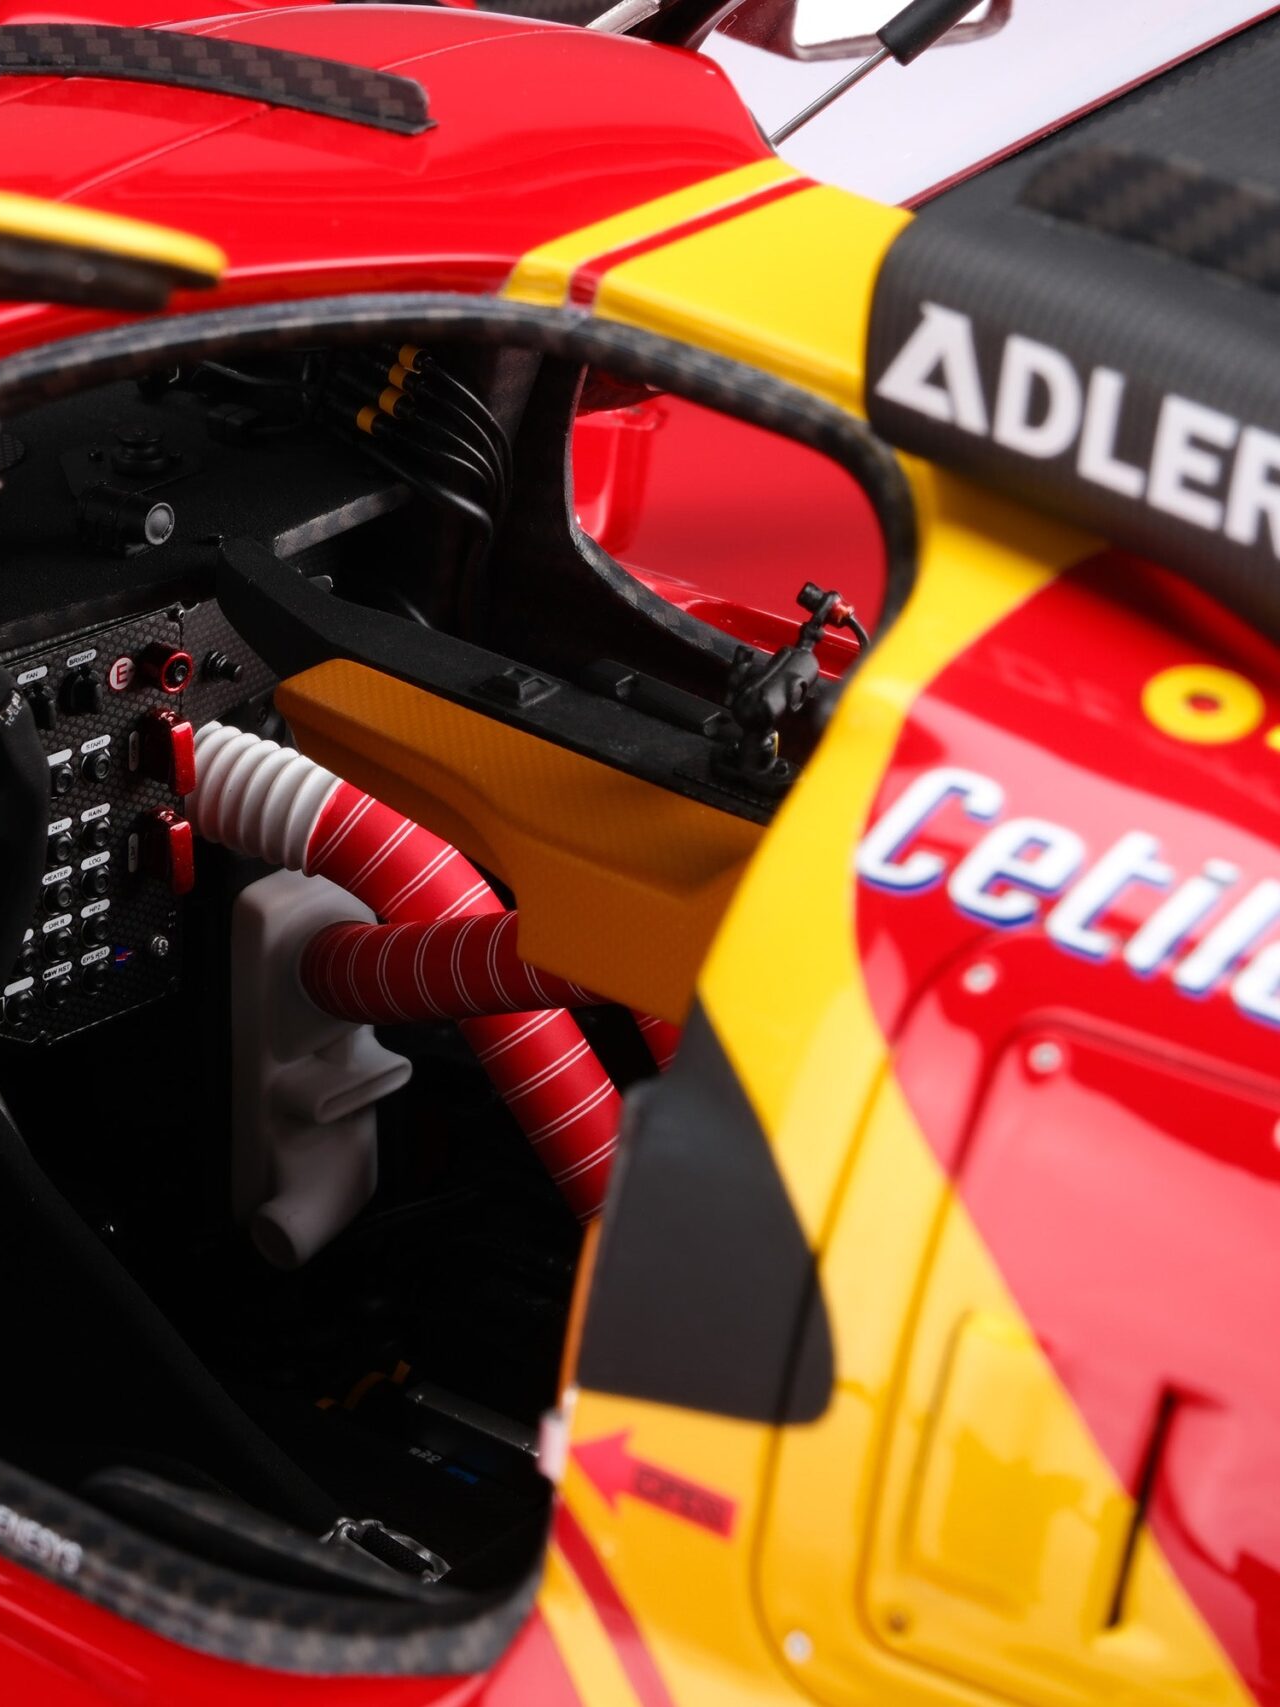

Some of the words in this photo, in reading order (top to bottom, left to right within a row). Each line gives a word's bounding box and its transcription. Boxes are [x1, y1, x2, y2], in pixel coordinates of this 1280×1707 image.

[876, 300, 1280, 556] ADLER
[69, 653, 94, 665] BRIGHT
[26, 671, 38, 680] FAN
[117, 663, 127, 685] E
[89, 808, 103, 817] RAIN
[89, 857, 102, 865] LOG
[44, 869, 69, 882] HEATER
[82, 955, 95, 964] EPS
